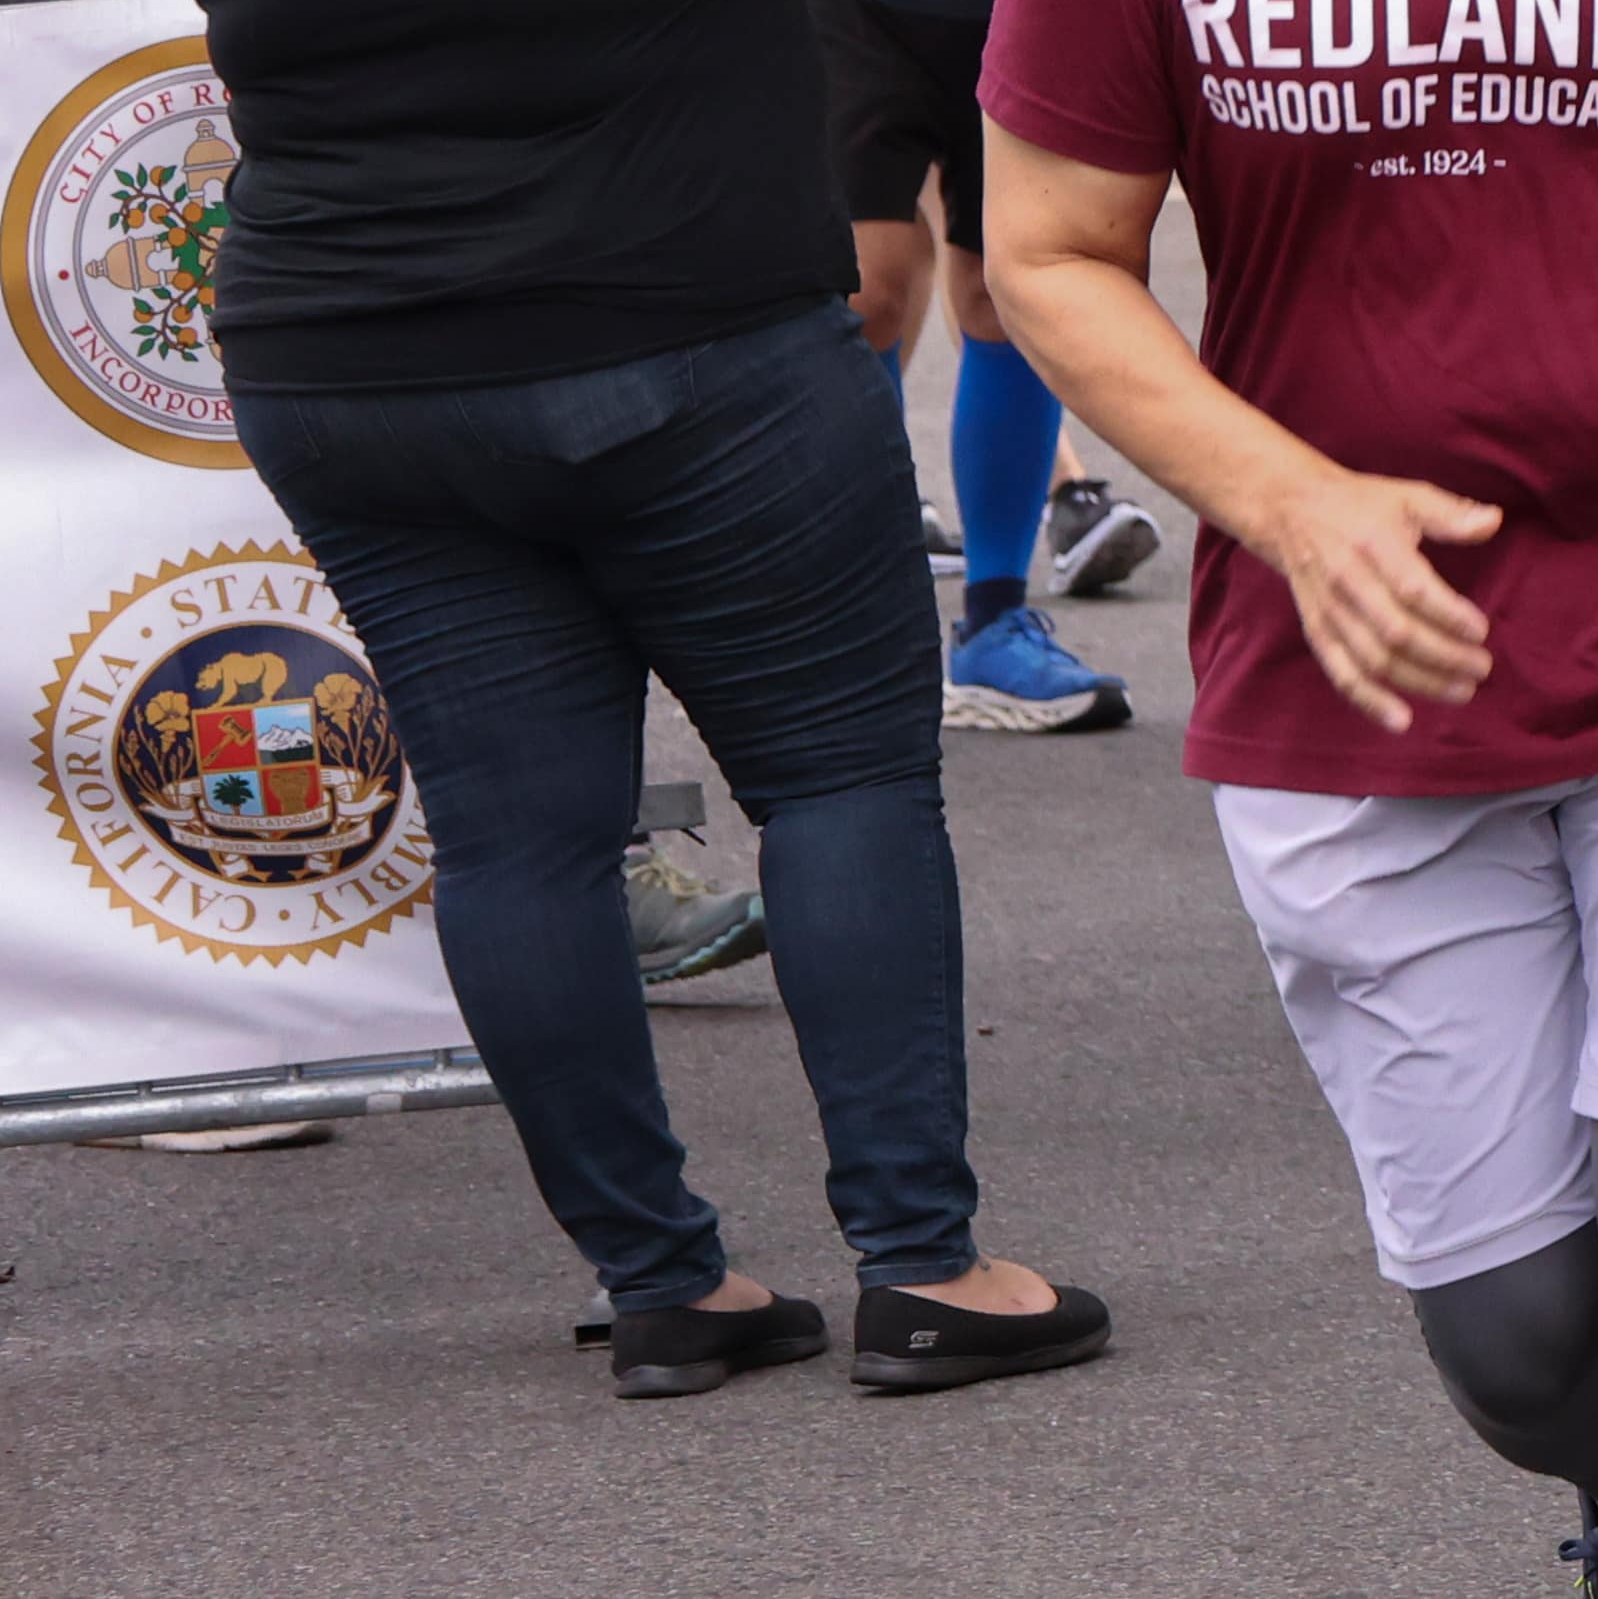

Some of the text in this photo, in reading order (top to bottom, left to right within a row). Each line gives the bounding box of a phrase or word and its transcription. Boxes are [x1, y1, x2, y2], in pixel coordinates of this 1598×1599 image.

[59, 122, 124, 206] CITY
[132, 90, 175, 126] OF
[1202, 76, 1371, 135] SCHOOL
[1382, 73, 1438, 129] OF
[1370, 148, 1488, 178] est. 1924
[64, 652, 258, 933] CALIFORNIA
